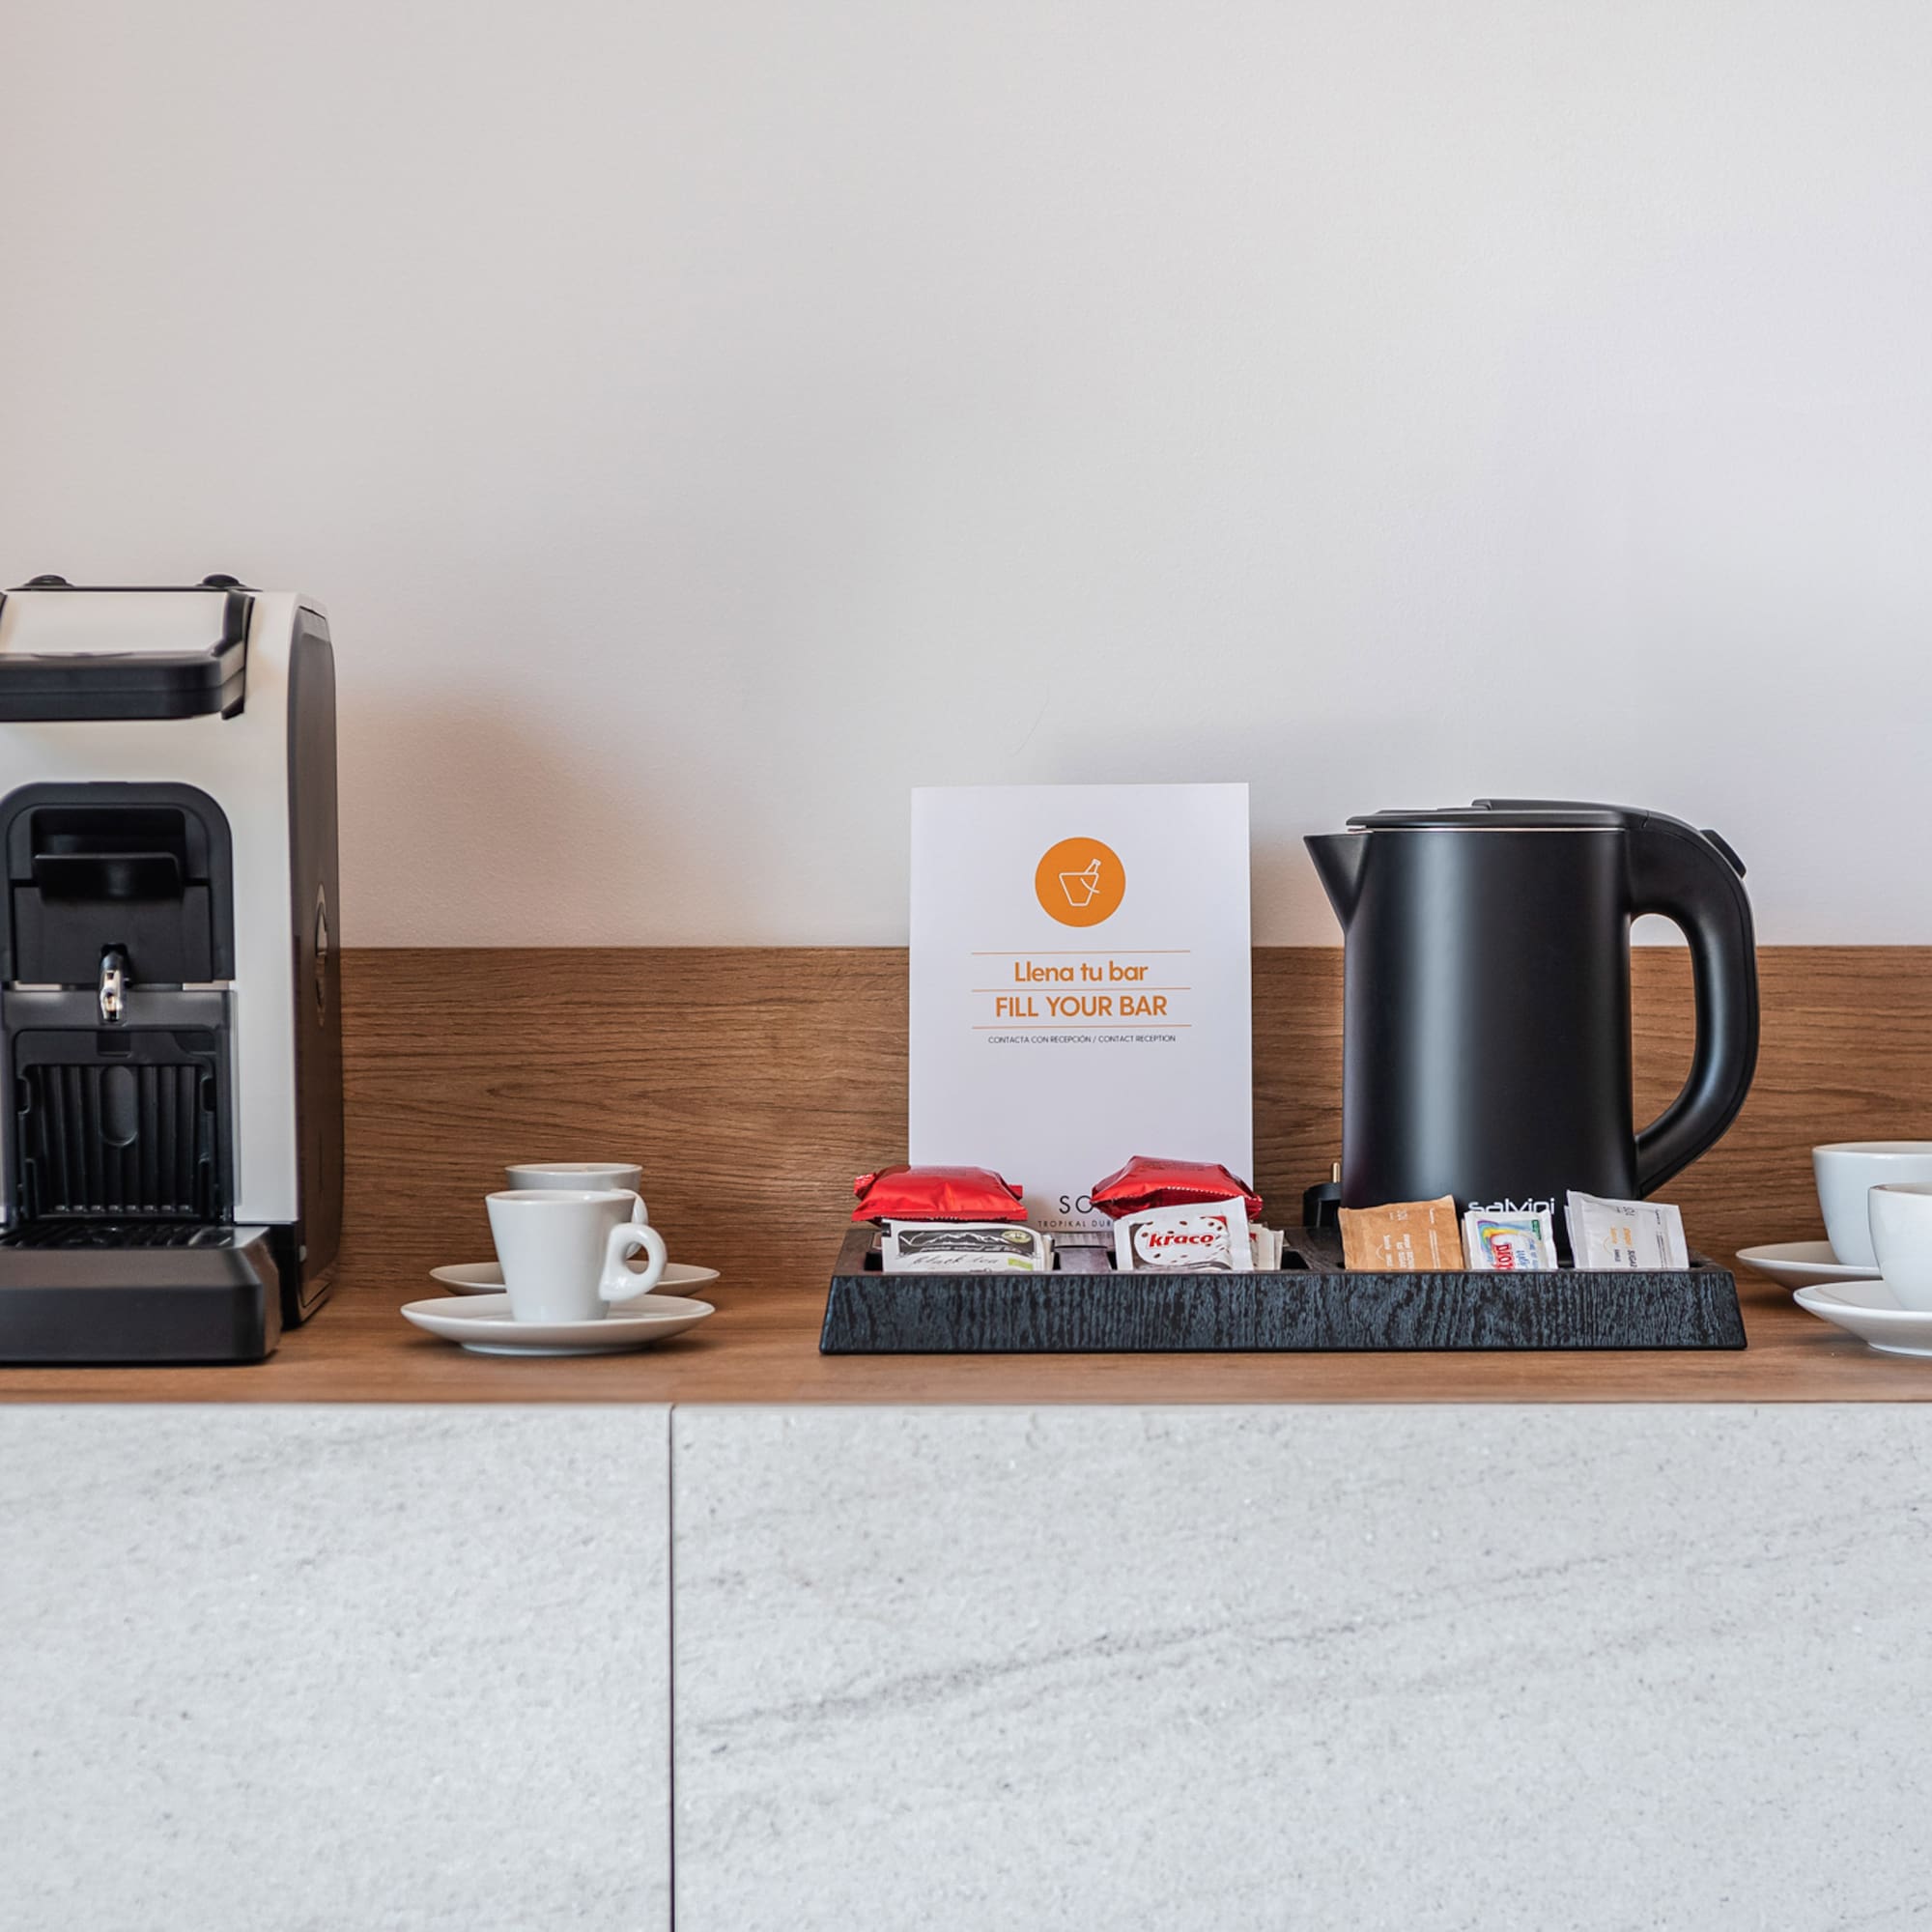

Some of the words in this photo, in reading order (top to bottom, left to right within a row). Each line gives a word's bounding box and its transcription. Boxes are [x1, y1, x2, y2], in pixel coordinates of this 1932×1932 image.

[1014, 961, 1074, 982] Llena
[1081, 963, 1103, 982] tu
[1109, 960, 1149, 981] bar
[995, 996, 1038, 1018] FILL
[1046, 995, 1113, 1017] YOUR
[1120, 995, 1168, 1017] BAR
[1050, 1035, 1092, 1043] RECEPCIÓN
[1135, 1035, 1177, 1043] RECEPTION
[1059, 1195, 1094, 1214] SO
[1149, 1233, 1214, 1248] kraco
